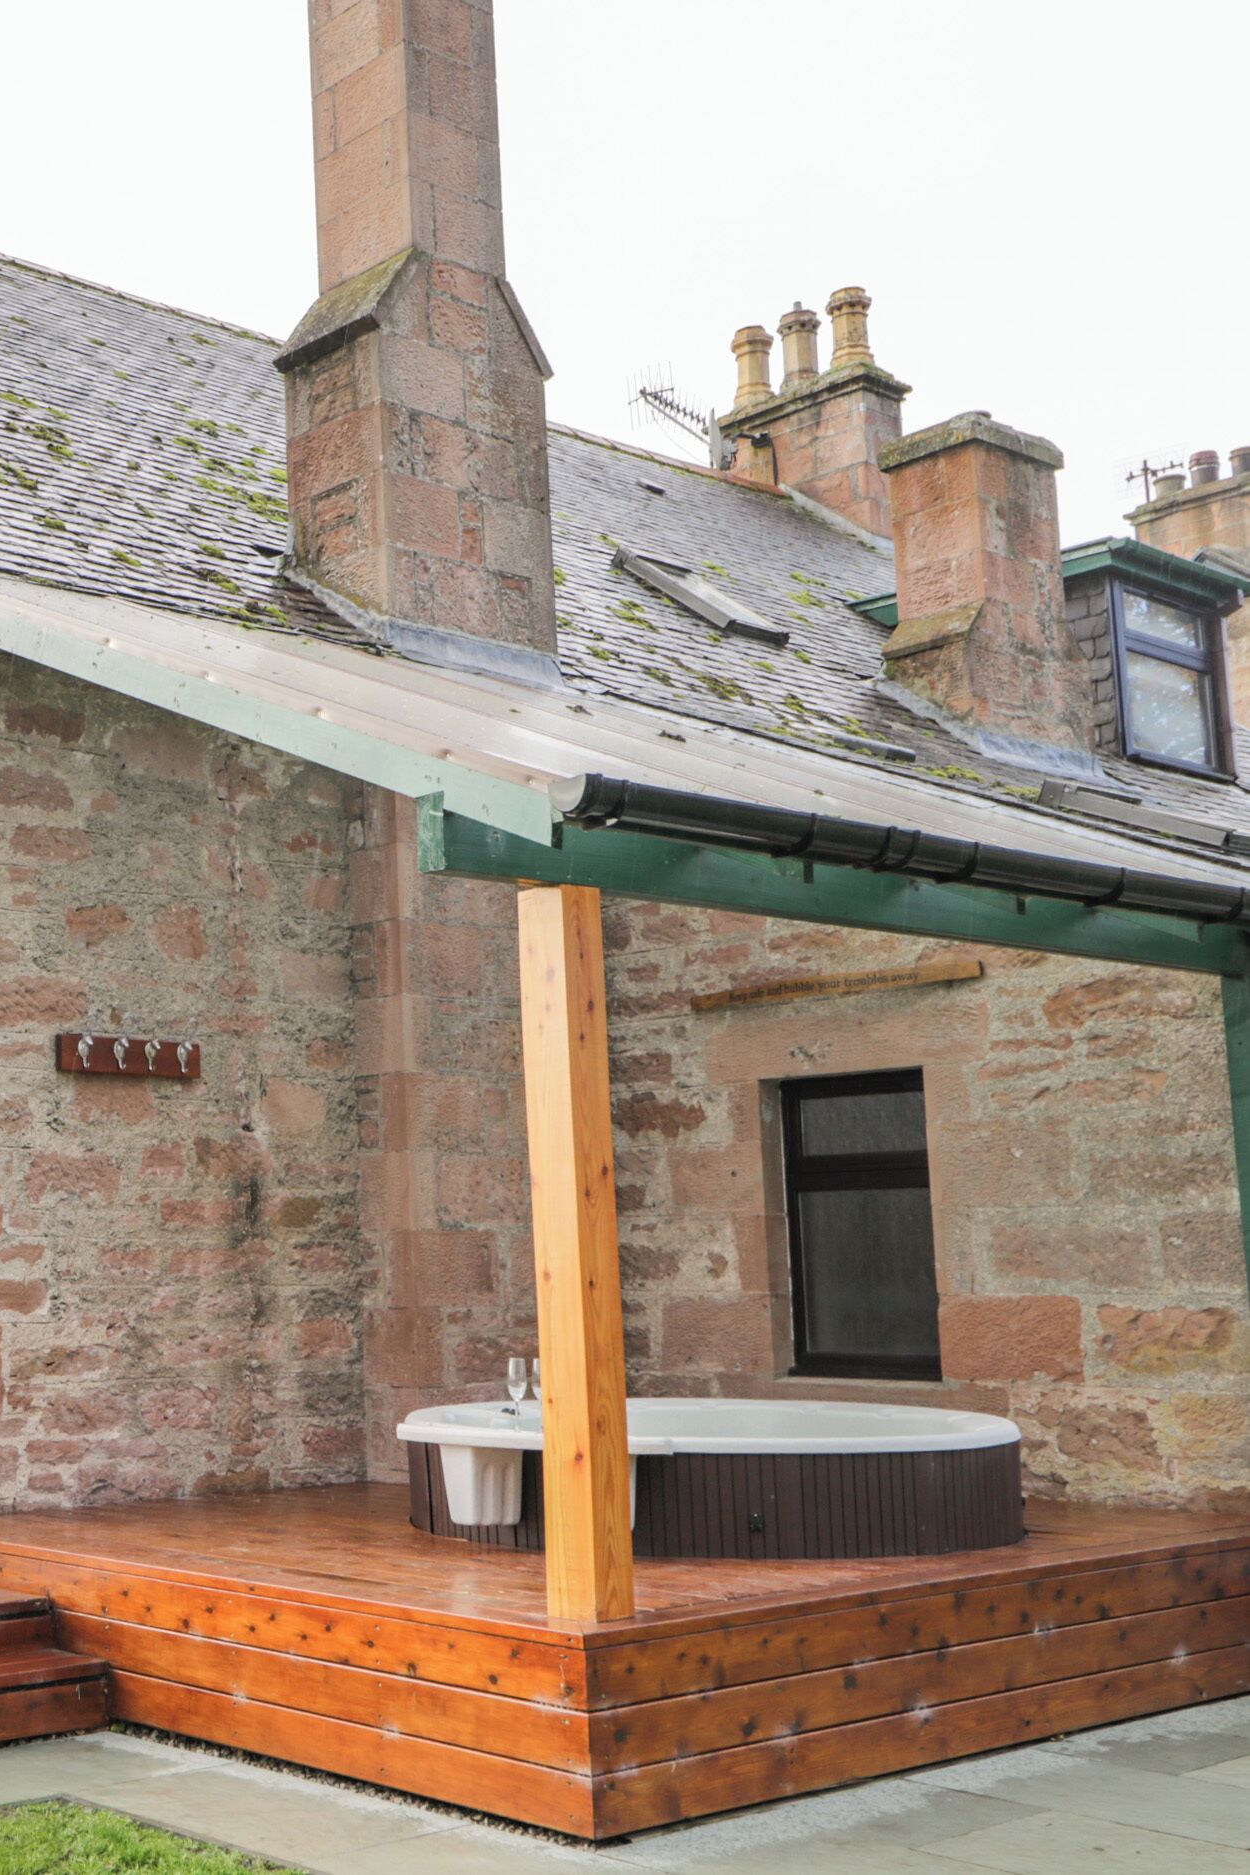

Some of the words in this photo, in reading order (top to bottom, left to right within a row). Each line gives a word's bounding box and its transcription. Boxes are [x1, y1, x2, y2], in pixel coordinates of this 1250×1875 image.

[784, 981, 815, 994] bubble
[817, 980, 841, 993] your
[844, 972, 889, 987] troubles
[890, 972, 919, 984] away
